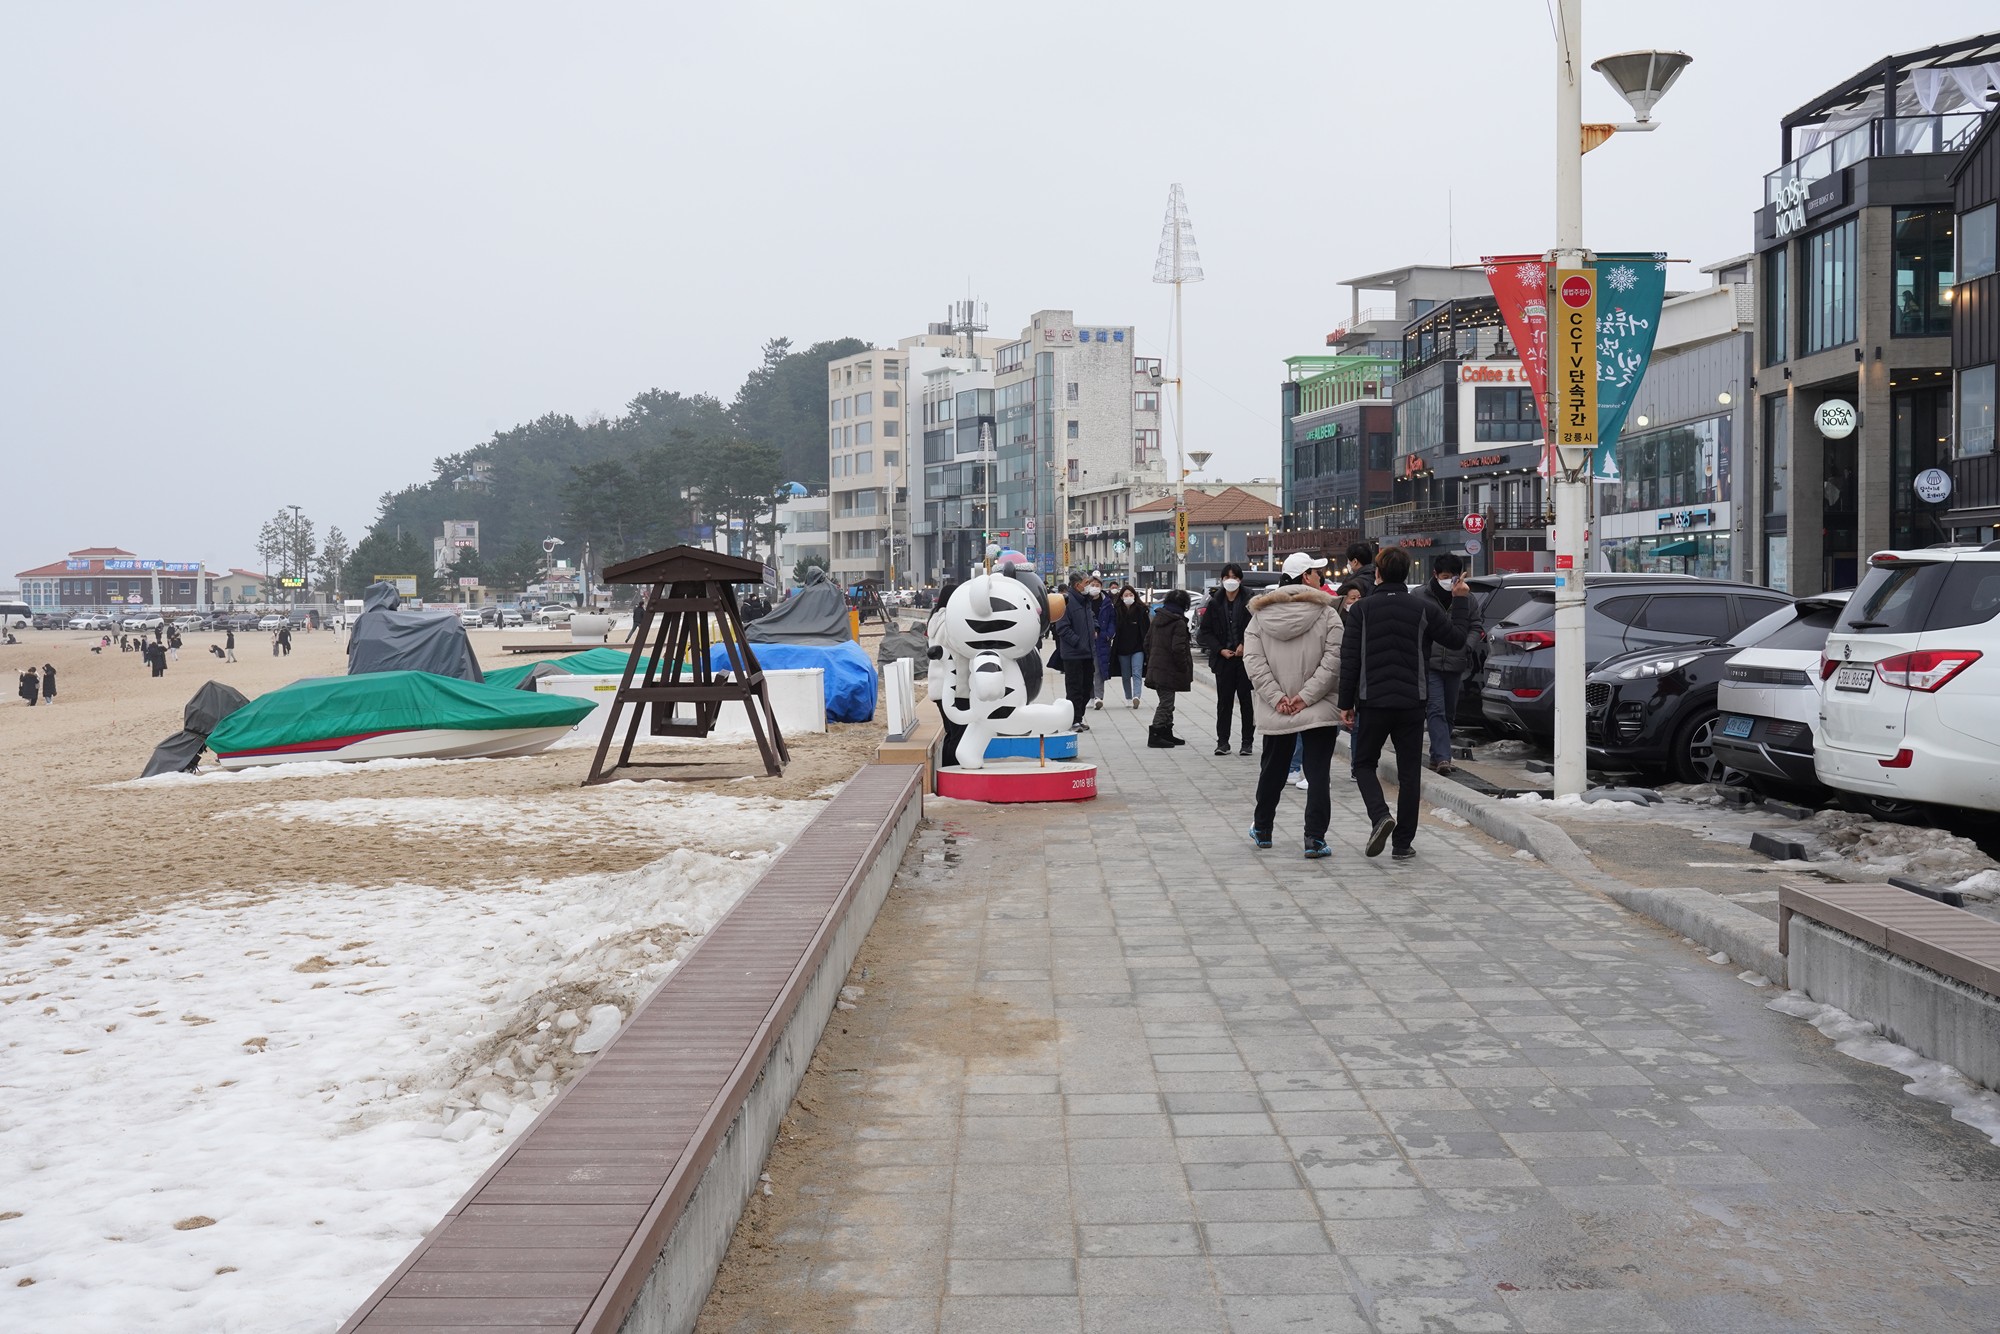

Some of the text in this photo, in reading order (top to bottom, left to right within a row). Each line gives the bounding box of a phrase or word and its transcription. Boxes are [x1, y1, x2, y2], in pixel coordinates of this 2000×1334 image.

[1776, 178, 1810, 213] BOSSA
[1807, 198, 1819, 211] COFFEE
[1776, 204, 1807, 238] NOVA
[1563, 288, 1590, 297] 불법주정차
[1462, 366, 1503, 382] Coffee
[1507, 368, 1516, 382] &
[1569, 313, 1586, 427] CCTV단속구간
[1822, 408, 1852, 418] BOSSA
[1822, 416, 1849, 426] NOVA
[1564, 433, 1592, 442] 강릉시
[1675, 511, 1690, 528] GS25
[1851, 672, 1868, 686] 8655
[1072, 780, 1085, 788] 2018
